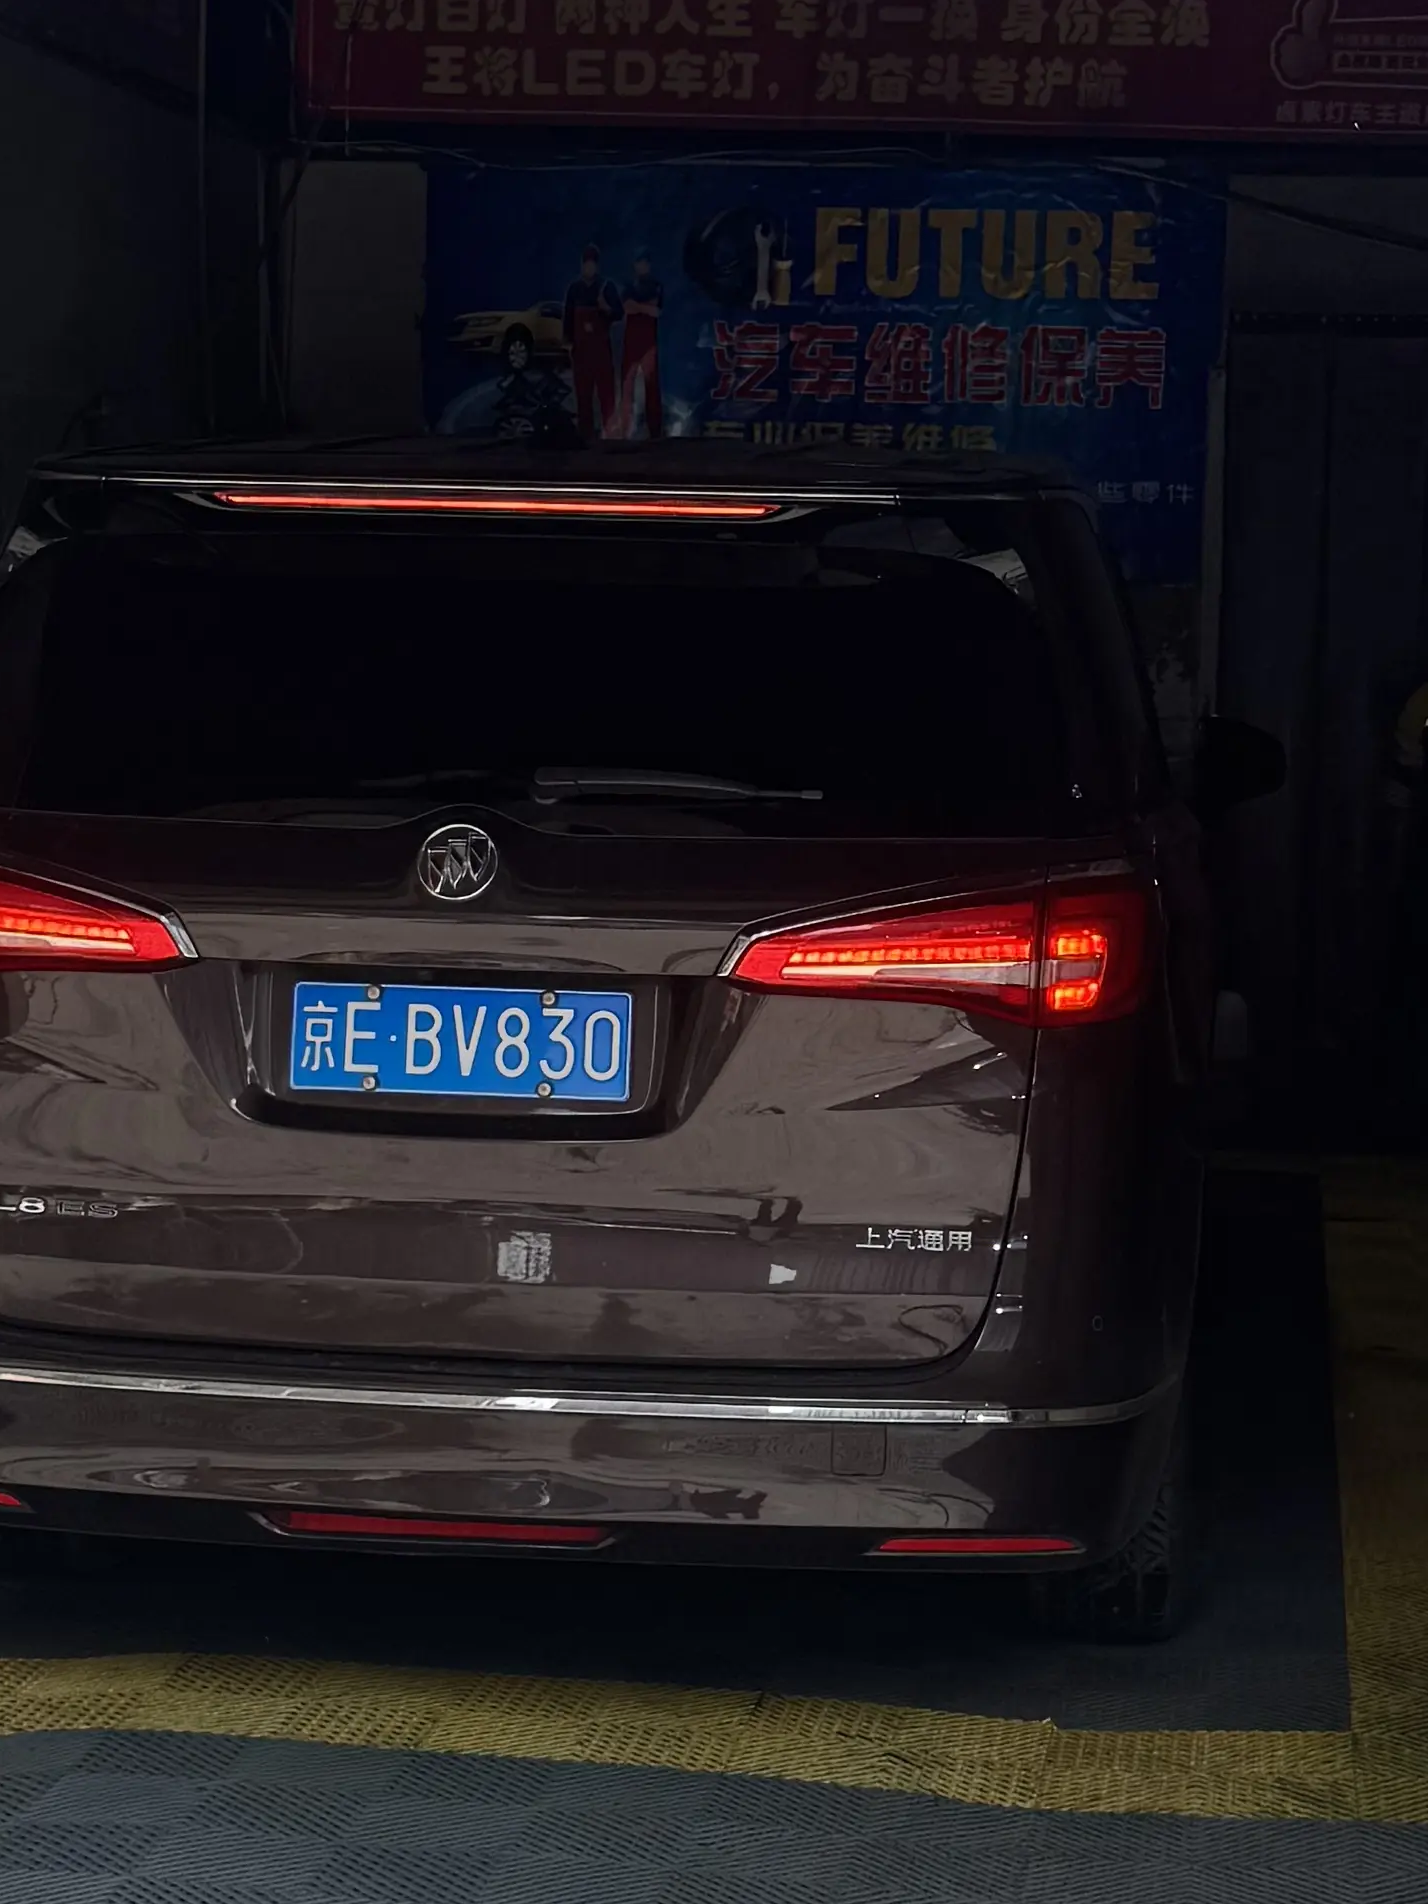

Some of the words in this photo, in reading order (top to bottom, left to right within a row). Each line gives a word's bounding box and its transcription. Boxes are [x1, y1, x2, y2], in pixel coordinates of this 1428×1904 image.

[813, 205, 1160, 303] FUTURE
[710, 320, 1167, 410] 汽车维修保养
[56, 1199, 120, 1219] ES
[855, 1225, 973, 1252] 上汽通用
